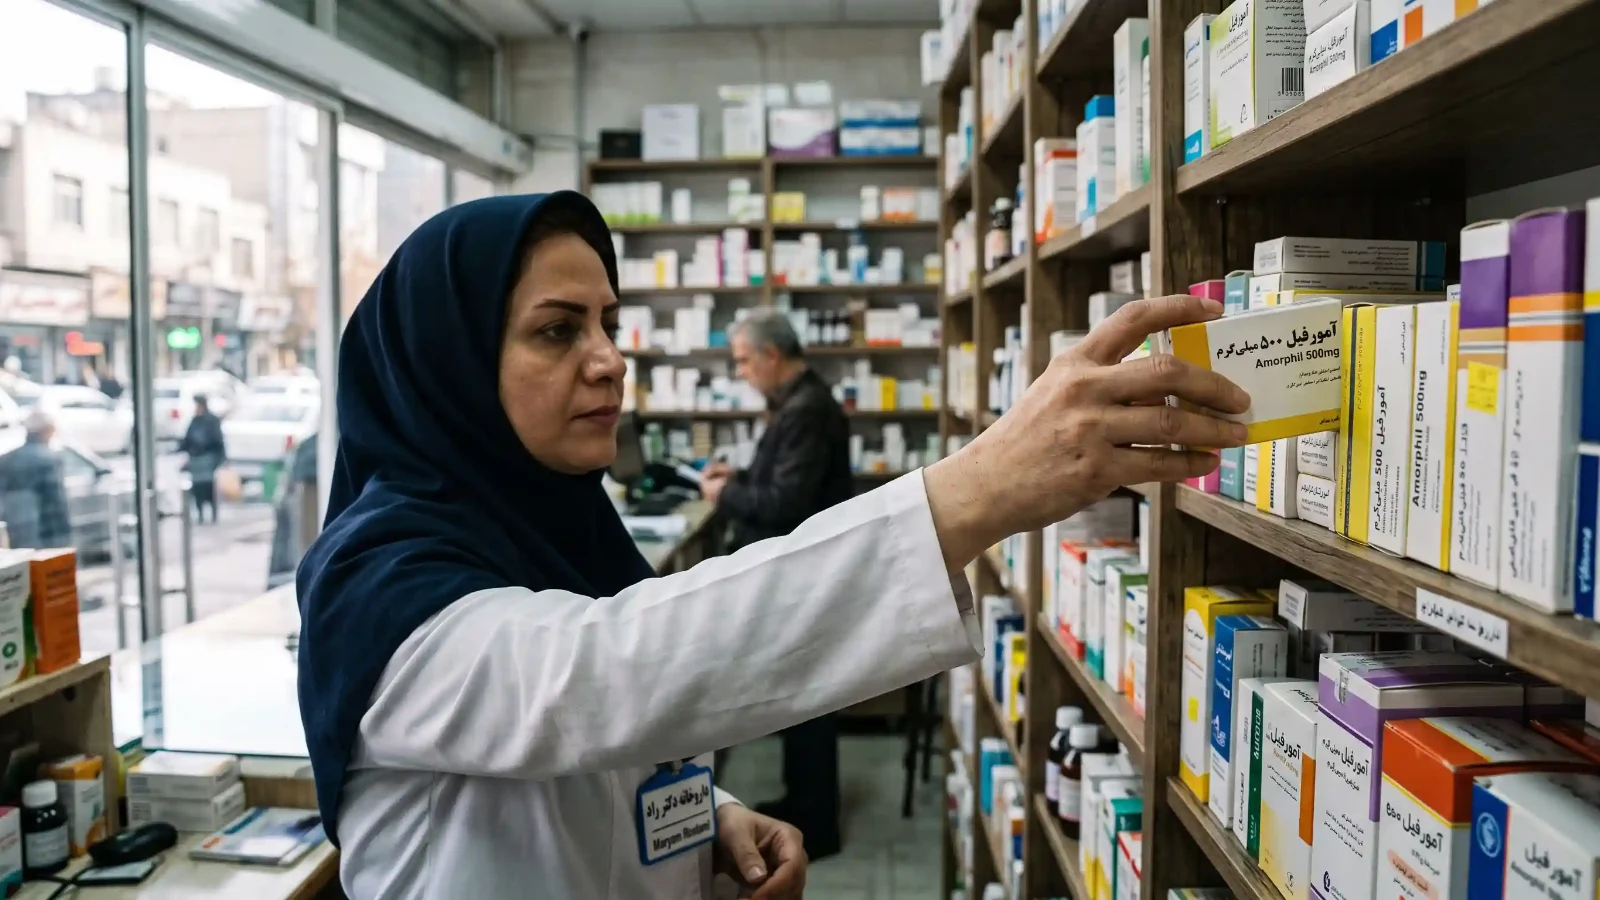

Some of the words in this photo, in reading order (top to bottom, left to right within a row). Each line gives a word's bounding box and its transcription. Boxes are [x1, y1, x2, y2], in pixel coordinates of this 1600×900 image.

[1260, 335, 1283, 350] ۵۰۰
[1286, 320, 1338, 348] آمورفیل
[1255, 351, 1304, 368] Amorphil
[1306, 348, 1340, 360] 500mg
[1376, 384, 1388, 445] آمورفیل
[1375, 449, 1383, 476] 500
[1412, 428, 1424, 507] Amorphil
[1271, 727, 1302, 760] آمورفیل
[1341, 746, 1370, 776] آمورفیل
[646, 801, 660, 820] راد
[662, 795, 678, 818] دکتر
[1402, 813, 1444, 852] آمورفیل
